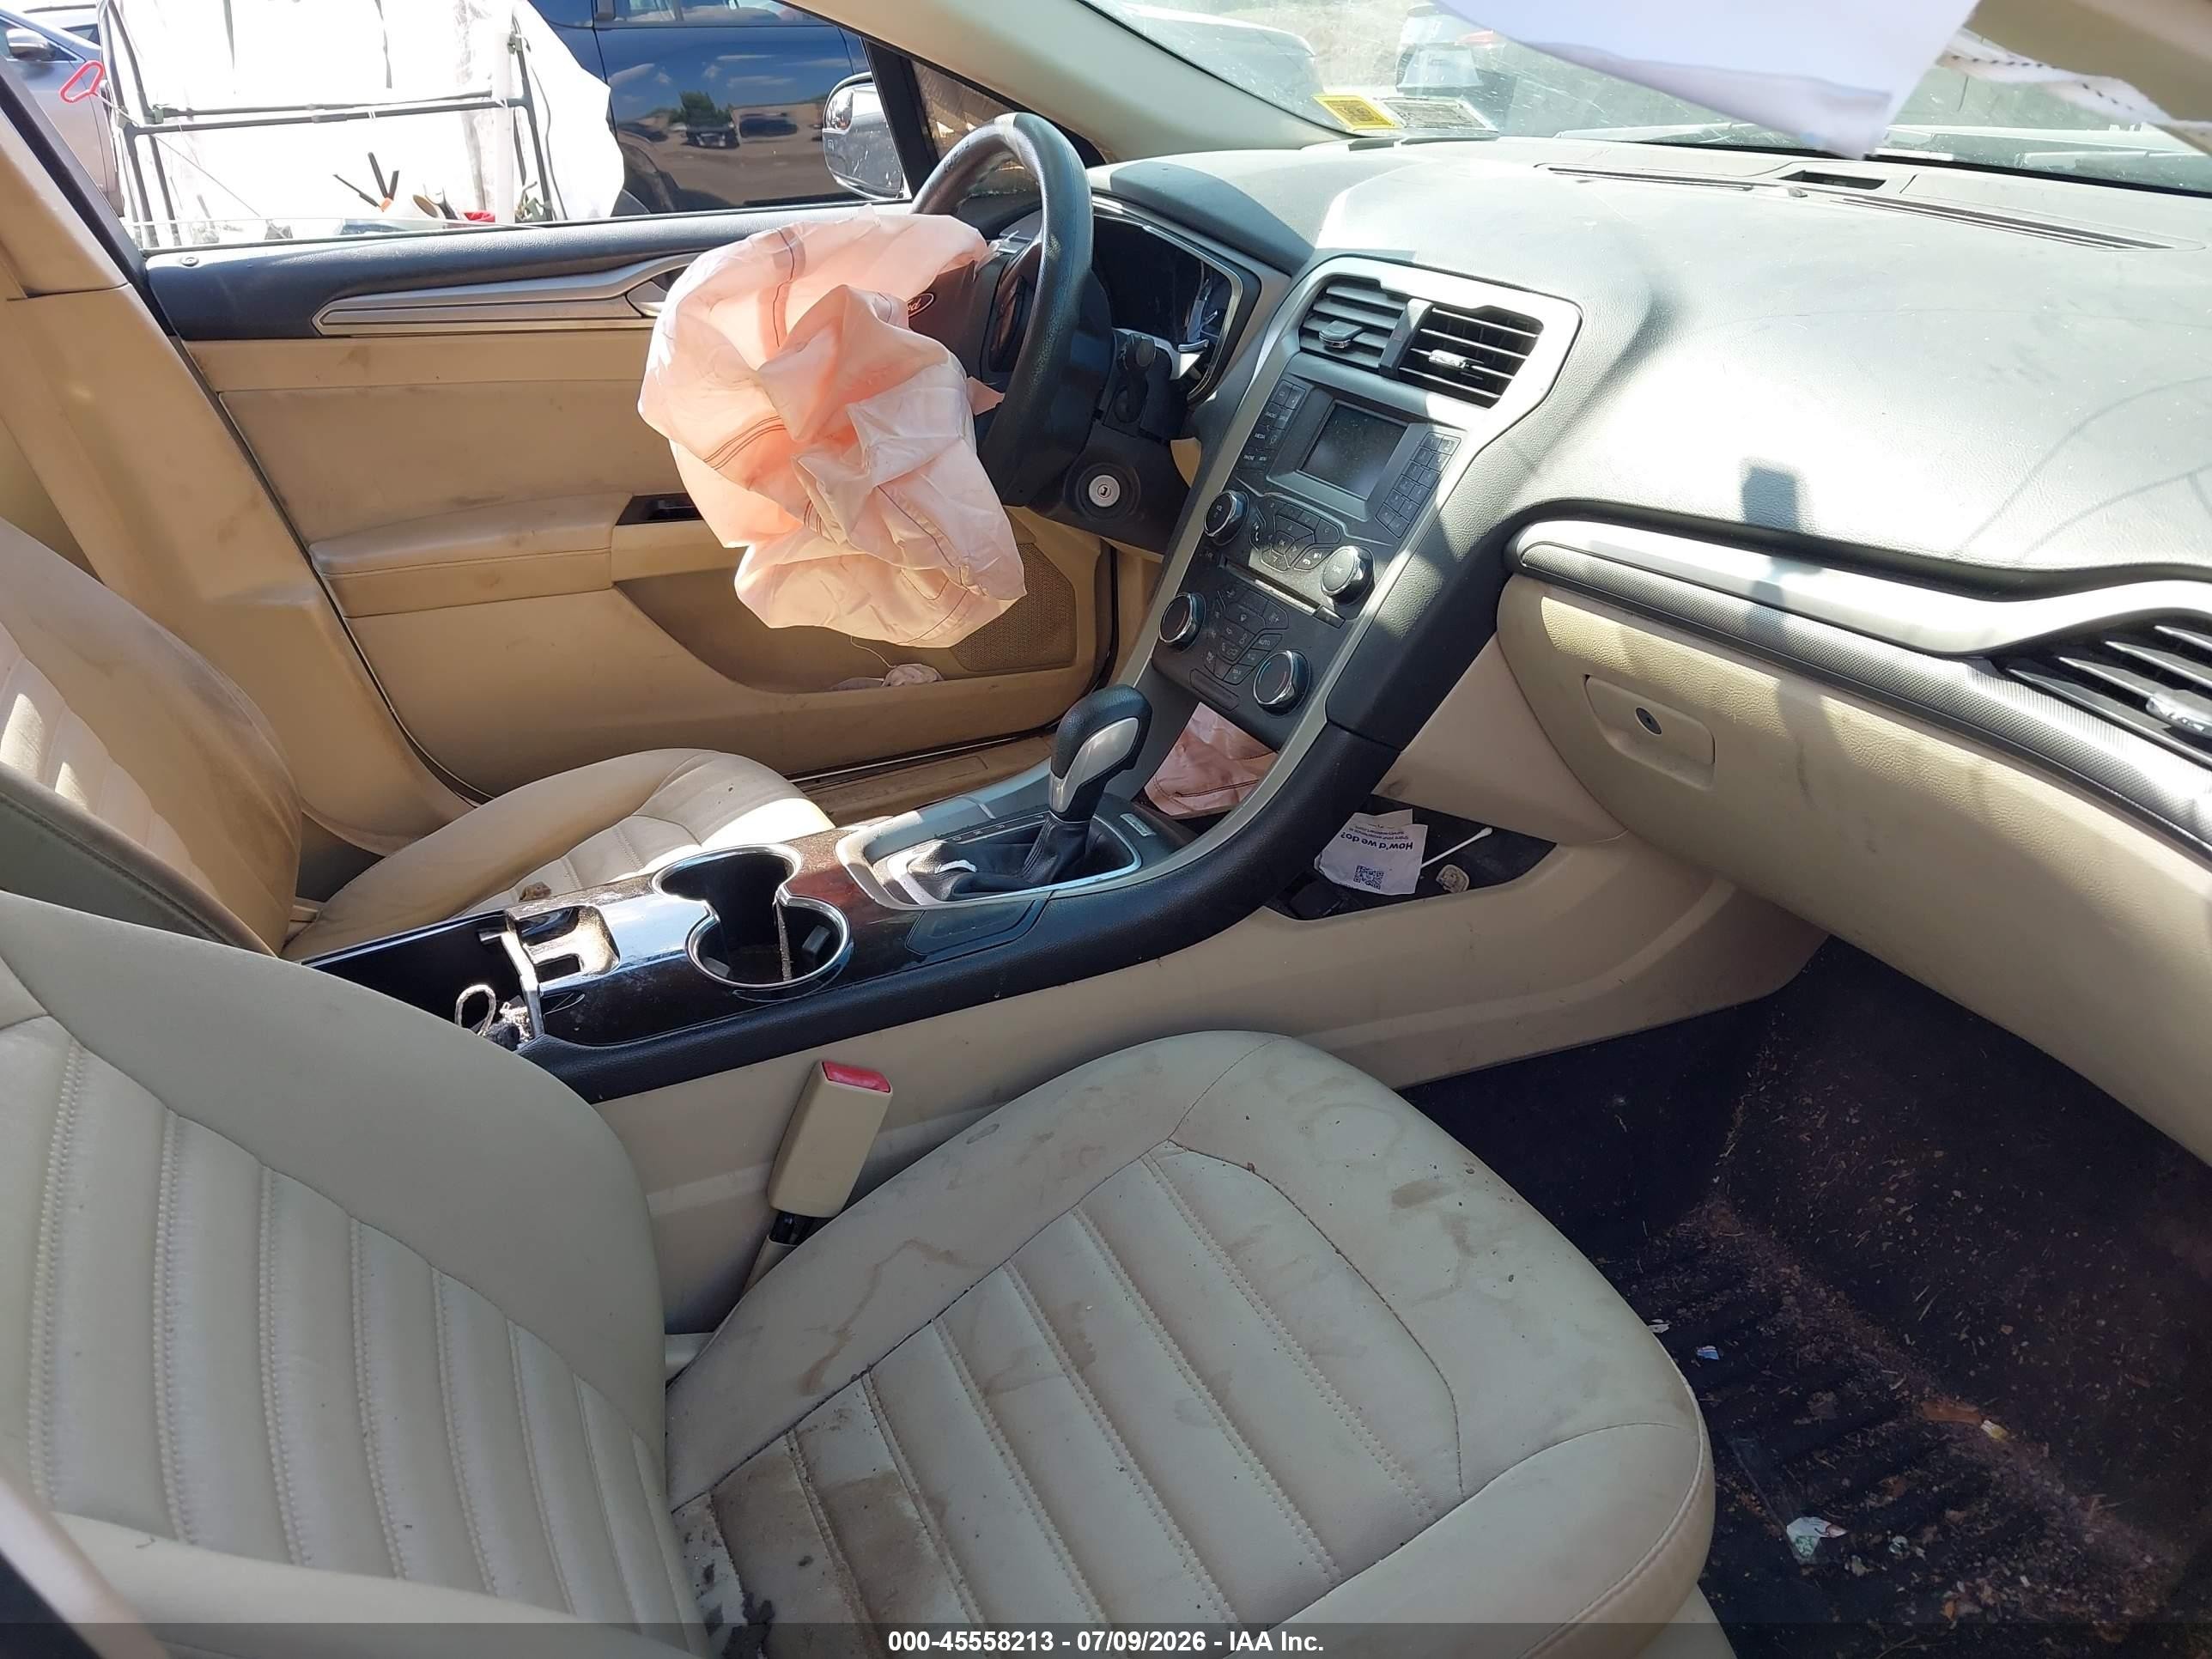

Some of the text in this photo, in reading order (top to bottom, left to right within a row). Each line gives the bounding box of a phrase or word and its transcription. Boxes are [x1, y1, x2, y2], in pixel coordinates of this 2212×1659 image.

[1340, 831, 1413, 850] How'd we do?
